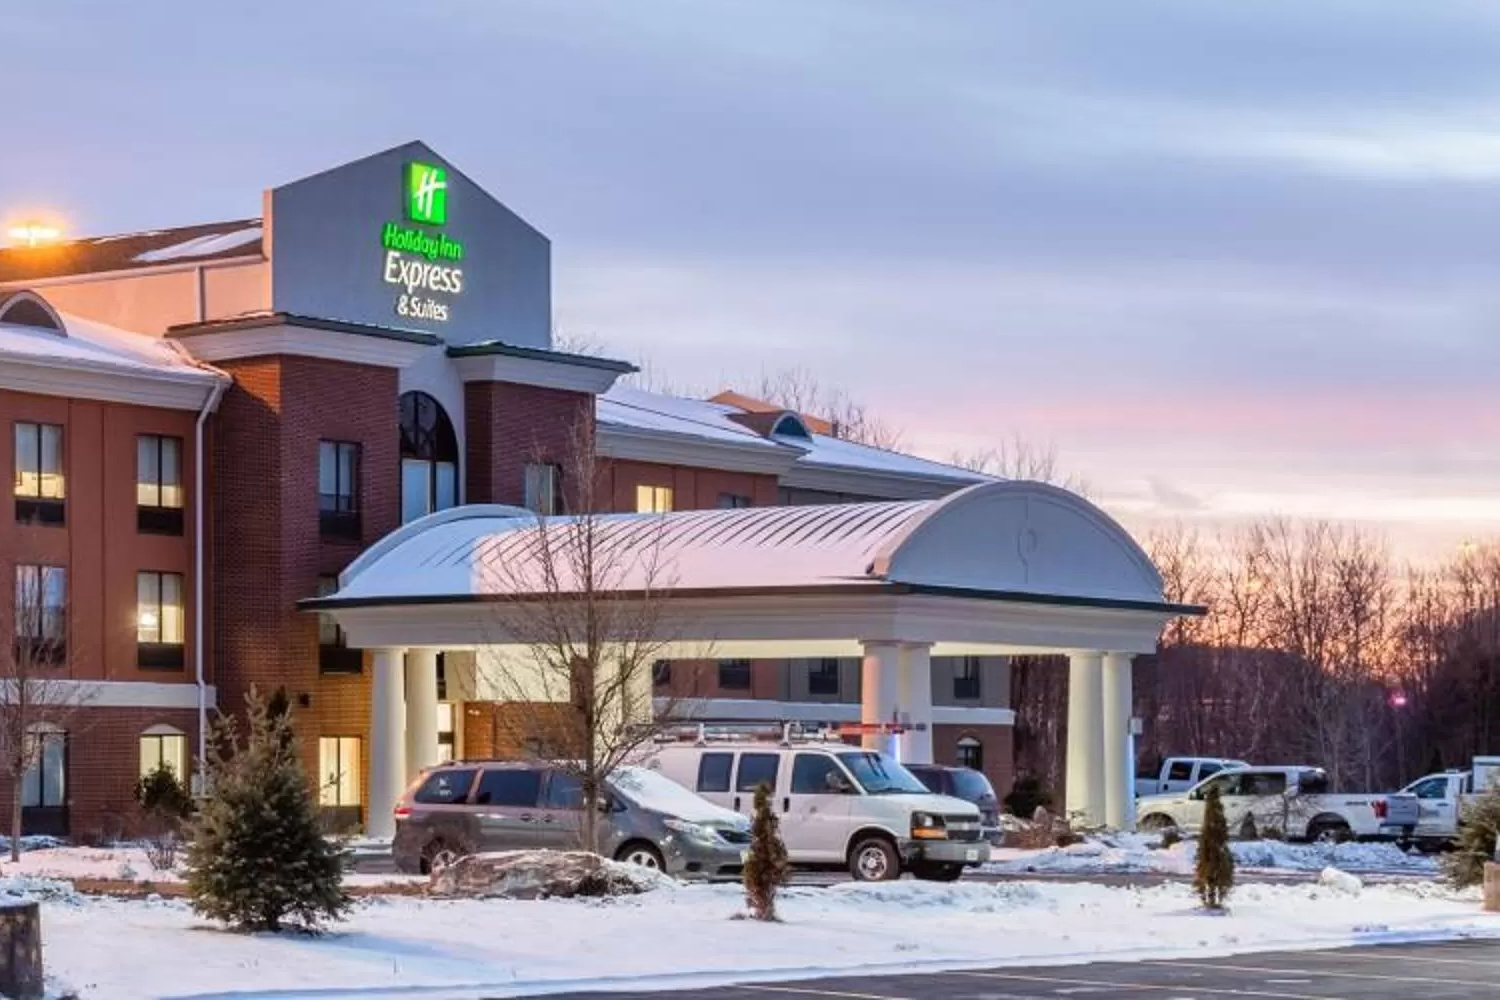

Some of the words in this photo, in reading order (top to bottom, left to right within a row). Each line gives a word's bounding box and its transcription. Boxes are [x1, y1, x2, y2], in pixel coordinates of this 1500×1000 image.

[384, 223, 438, 259] Holiday
[439, 234, 462, 259] Inn
[384, 251, 462, 294] Express
[397, 296, 408, 316] &
[410, 298, 448, 321] Suites
